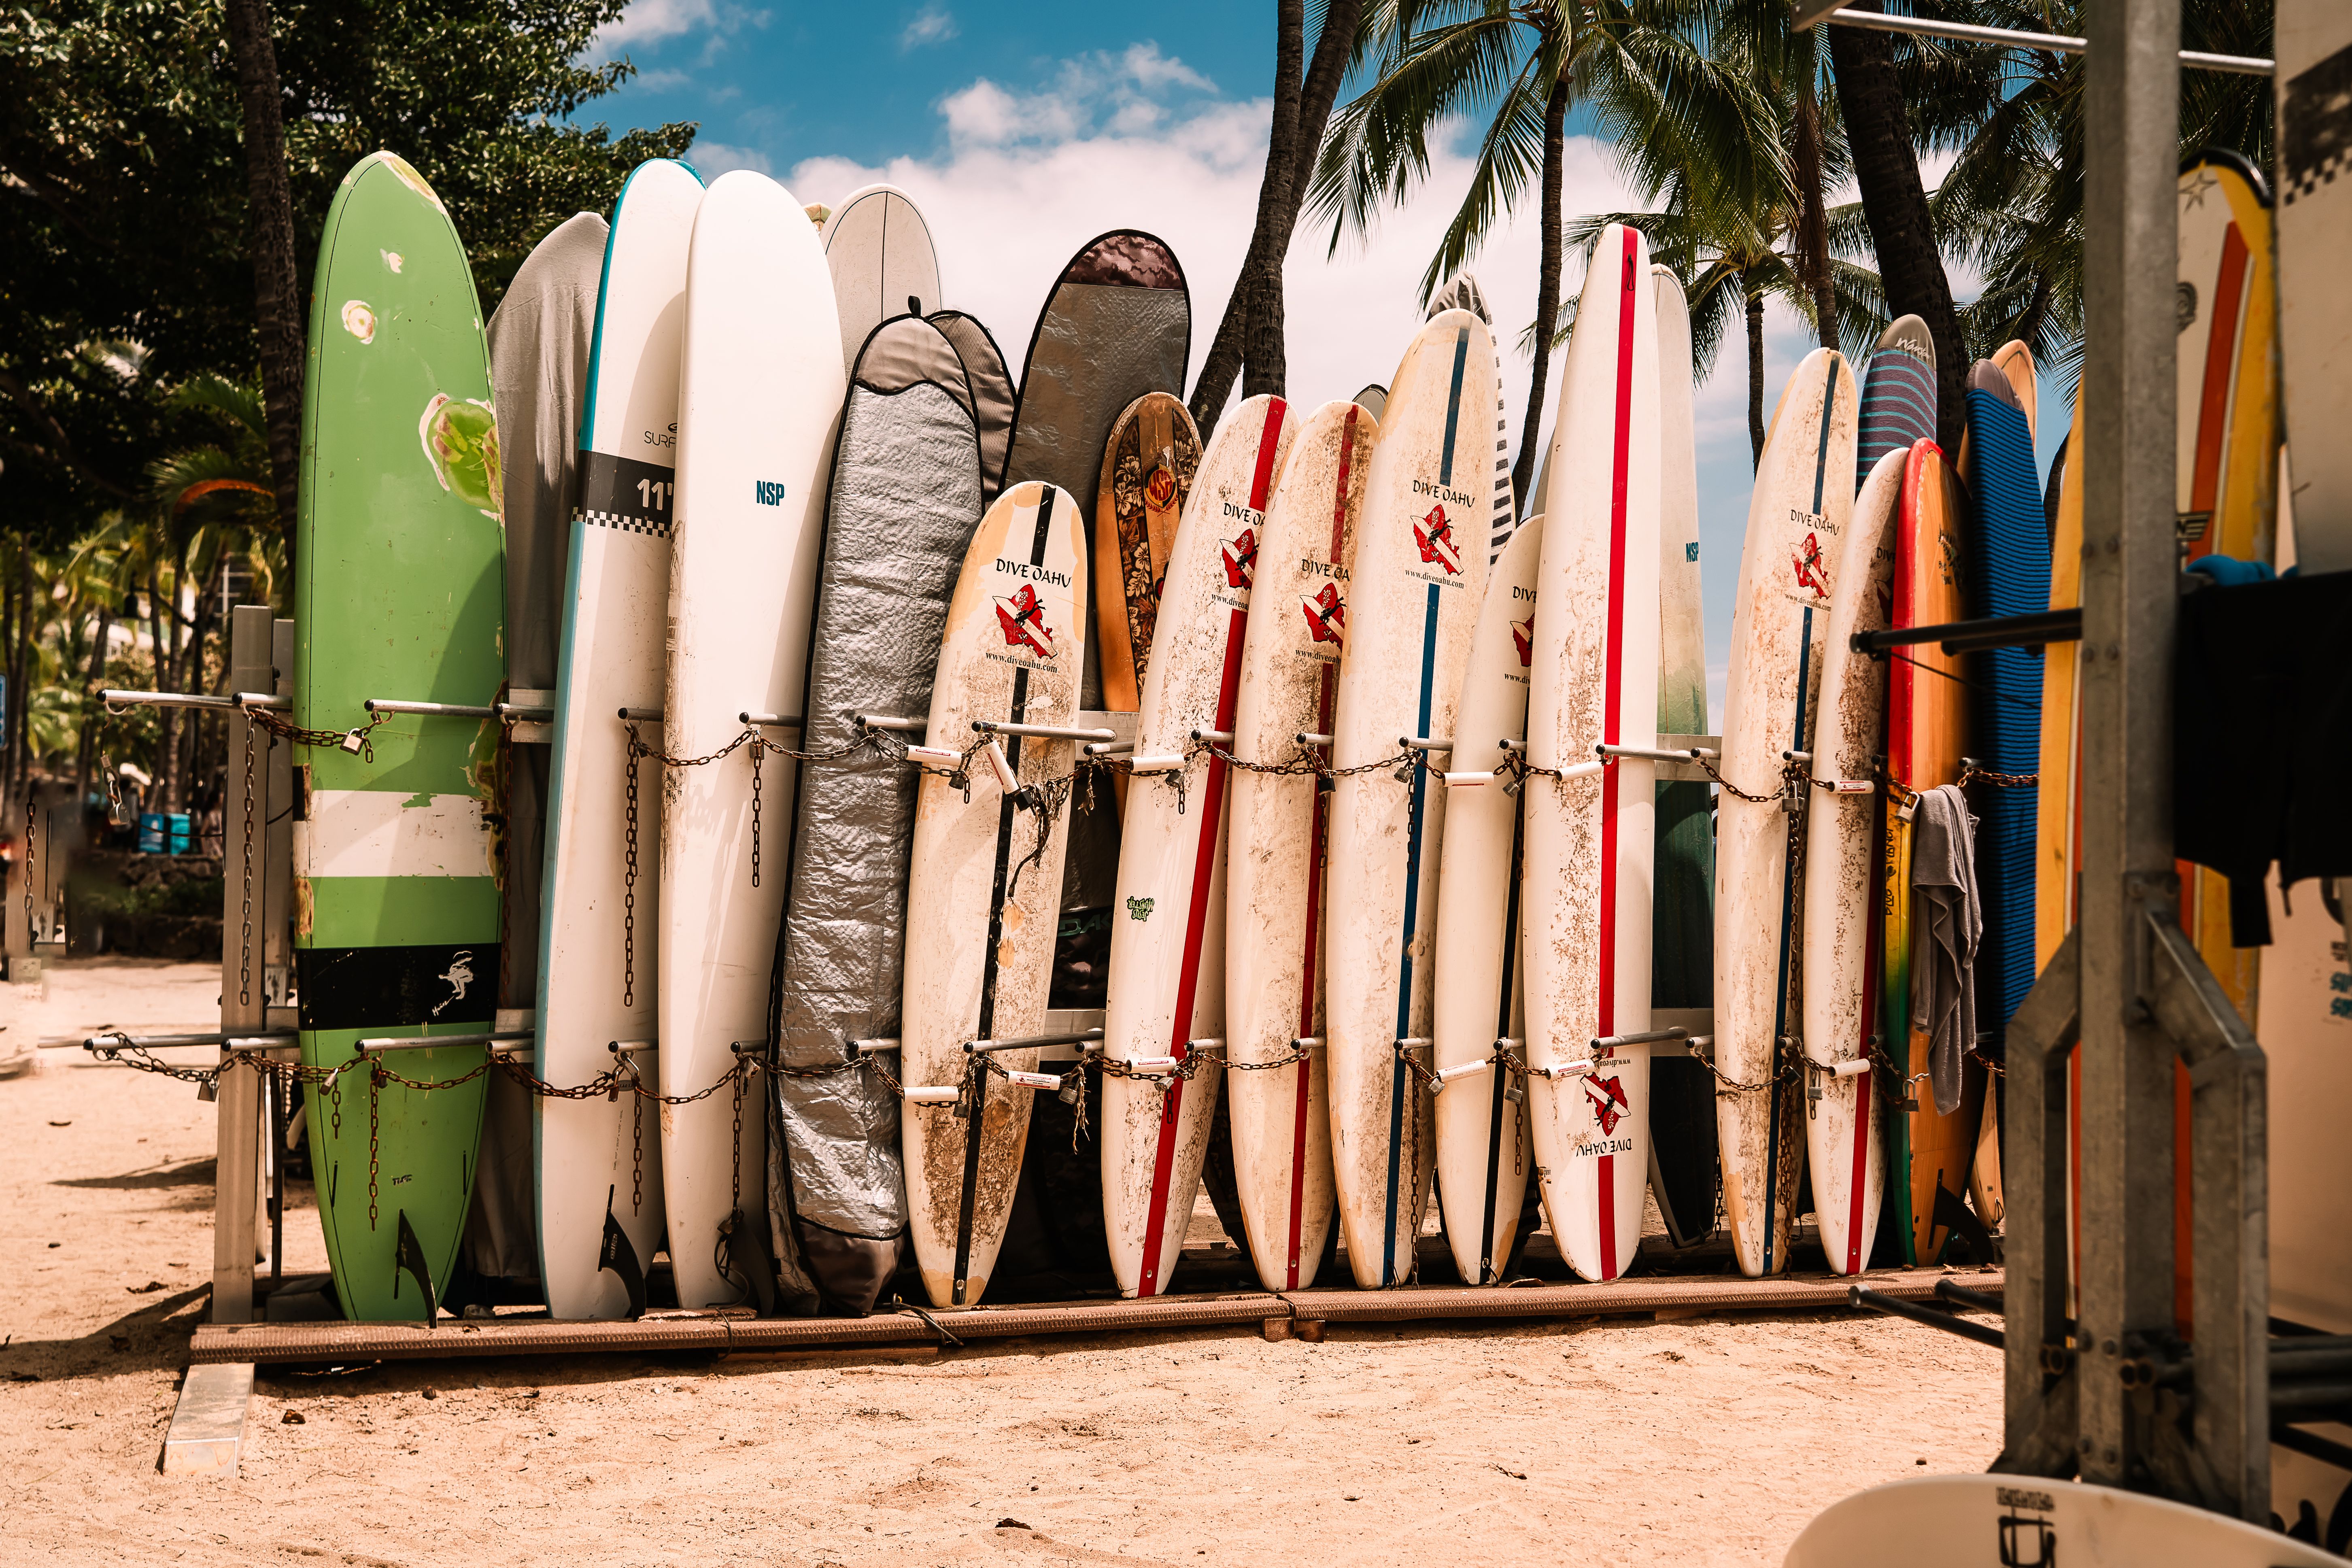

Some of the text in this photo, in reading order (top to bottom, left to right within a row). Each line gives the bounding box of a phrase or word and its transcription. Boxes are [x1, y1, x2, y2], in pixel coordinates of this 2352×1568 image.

[756, 480, 784, 506] NSP
[1413, 480, 1475, 508] DIVE OAHU
[1224, 502, 1251, 523] DIVE
[1791, 509, 1840, 536] DIVE OAHU
[1686, 542, 1699, 563] NSP
[996, 559, 1072, 588] DIVE OAHU
[1301, 559, 1331, 577] DIVE
[1404, 568, 1464, 590] www.diveoahu.com
[986, 652, 1058, 674] www.diveoahu.com
[1576, 1138, 1632, 1157] DIVE OAHU
